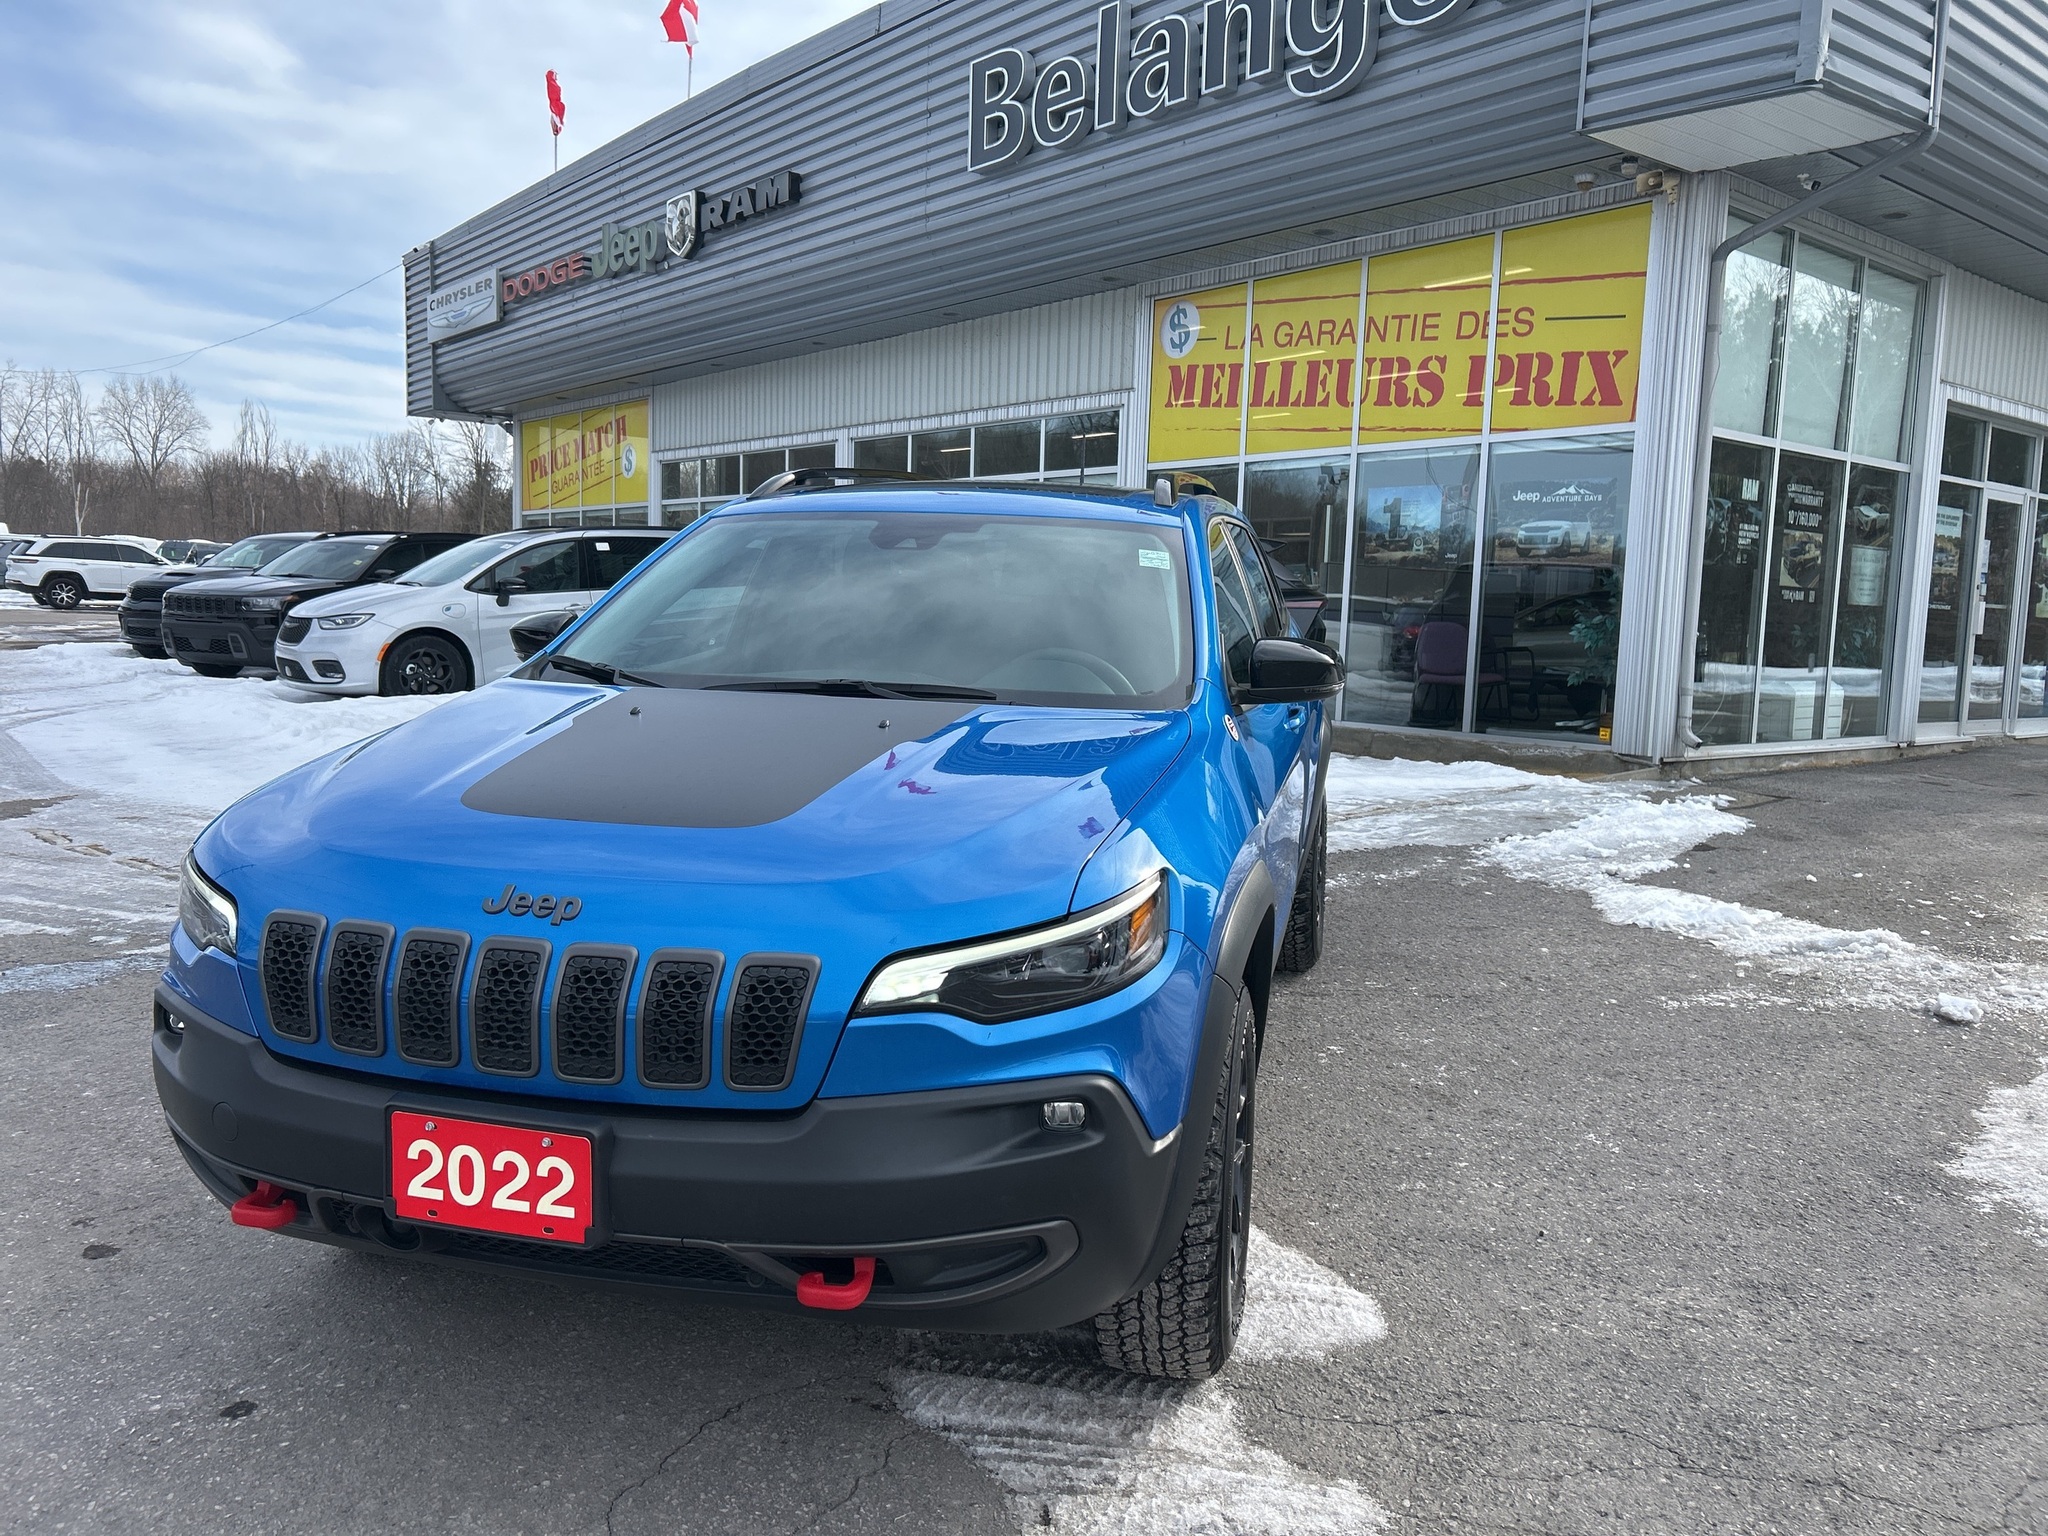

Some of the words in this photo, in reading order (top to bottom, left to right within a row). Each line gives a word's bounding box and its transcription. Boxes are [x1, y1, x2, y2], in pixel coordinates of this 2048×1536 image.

[968, 0, 1465, 170] Belang
[701, 171, 794, 232] RAM
[591, 220, 660, 279] Jeep
[429, 277, 493, 311] CHRYSLER
[503, 252, 587, 302] DODGE
[1225, 323, 1264, 350] LA
[1273, 312, 1442, 348] GARANTIE
[1456, 306, 1535, 340] DES
[1165, 354, 1447, 408] MEILLEURS
[1462, 350, 1629, 408] PRIX
[529, 442, 571, 483] PRICE
[574, 415, 627, 463] MATCH
[551, 459, 605, 494] GUARANTEE
[1512, 490, 1540, 503] Jeep
[1541, 494, 1582, 503] ADVENTURE
[1584, 494, 1602, 502] DAYS
[1741, 477, 1760, 502] RAM
[482, 883, 583, 926] Jeep
[407, 1139, 576, 1219] 2022
